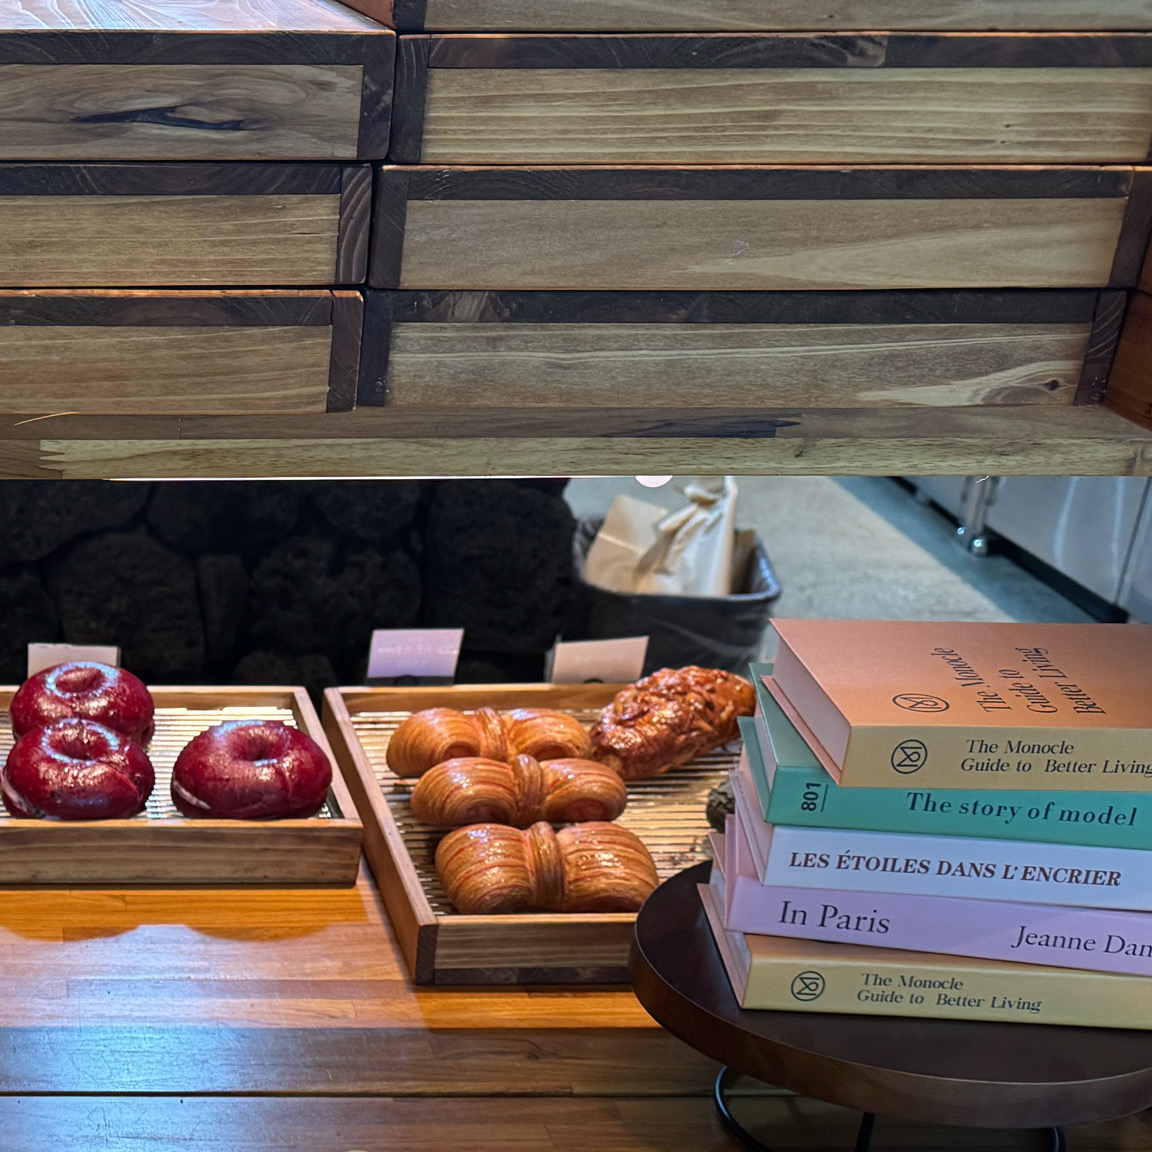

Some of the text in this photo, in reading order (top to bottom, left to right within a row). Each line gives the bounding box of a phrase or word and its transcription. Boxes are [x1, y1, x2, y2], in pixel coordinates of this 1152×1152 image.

[930, 647, 1013, 713] The Monocle
[998, 669, 1058, 714] Guide to
[1015, 647, 1107, 715] Better Living
[966, 739, 1075, 755] The Monocle
[960, 758, 1010, 772] Guide
[1016, 759, 1032, 772] to
[1044, 759, 1097, 773] Better
[906, 792, 1138, 826] The story of model
[789, 852, 830, 868] LES
[835, 850, 931, 875] ÉTOILES
[935, 860, 997, 878] DANS
[778, 900, 891, 934] In Paris
[1010, 925, 1097, 951] Jeanne
[861, 973, 964, 990] The Monocle
[856, 990, 1042, 1014] Guide to Better Living
